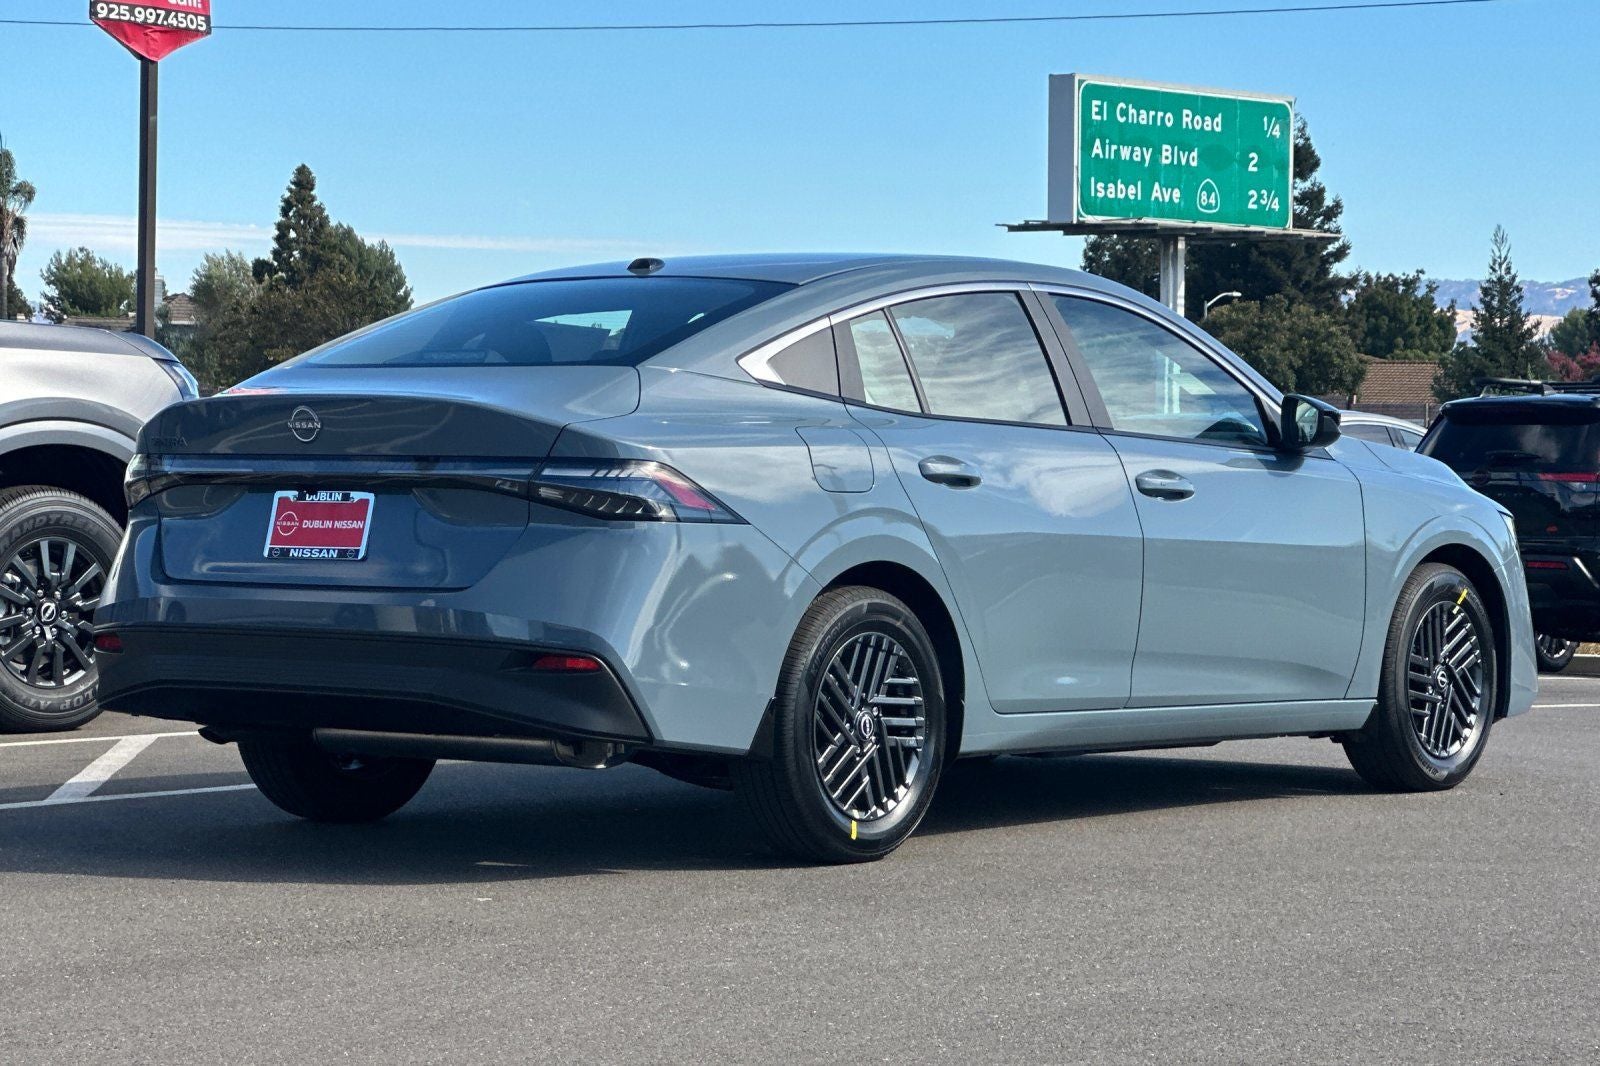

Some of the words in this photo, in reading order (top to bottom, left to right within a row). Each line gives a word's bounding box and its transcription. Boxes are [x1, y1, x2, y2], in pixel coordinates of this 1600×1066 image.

[97, 3, 206, 30] 925.997.4505
[1091, 100, 1107, 121] El
[1116, 102, 1174, 127] Charro
[1182, 109, 1222, 132] Road
[1091, 138, 1153, 167] Airway
[1161, 144, 1199, 167] Blvd
[1247, 153, 1259, 172] 2
[1090, 177, 1142, 200] Isabel
[1151, 182, 1181, 203] Ave
[1200, 190, 1216, 206] 84
[287, 421, 321, 429] NISSAN
[302, 520, 332, 528] DUBLIN
[334, 520, 364, 529] NISSAN
[289, 549, 338, 558] NISSAN
